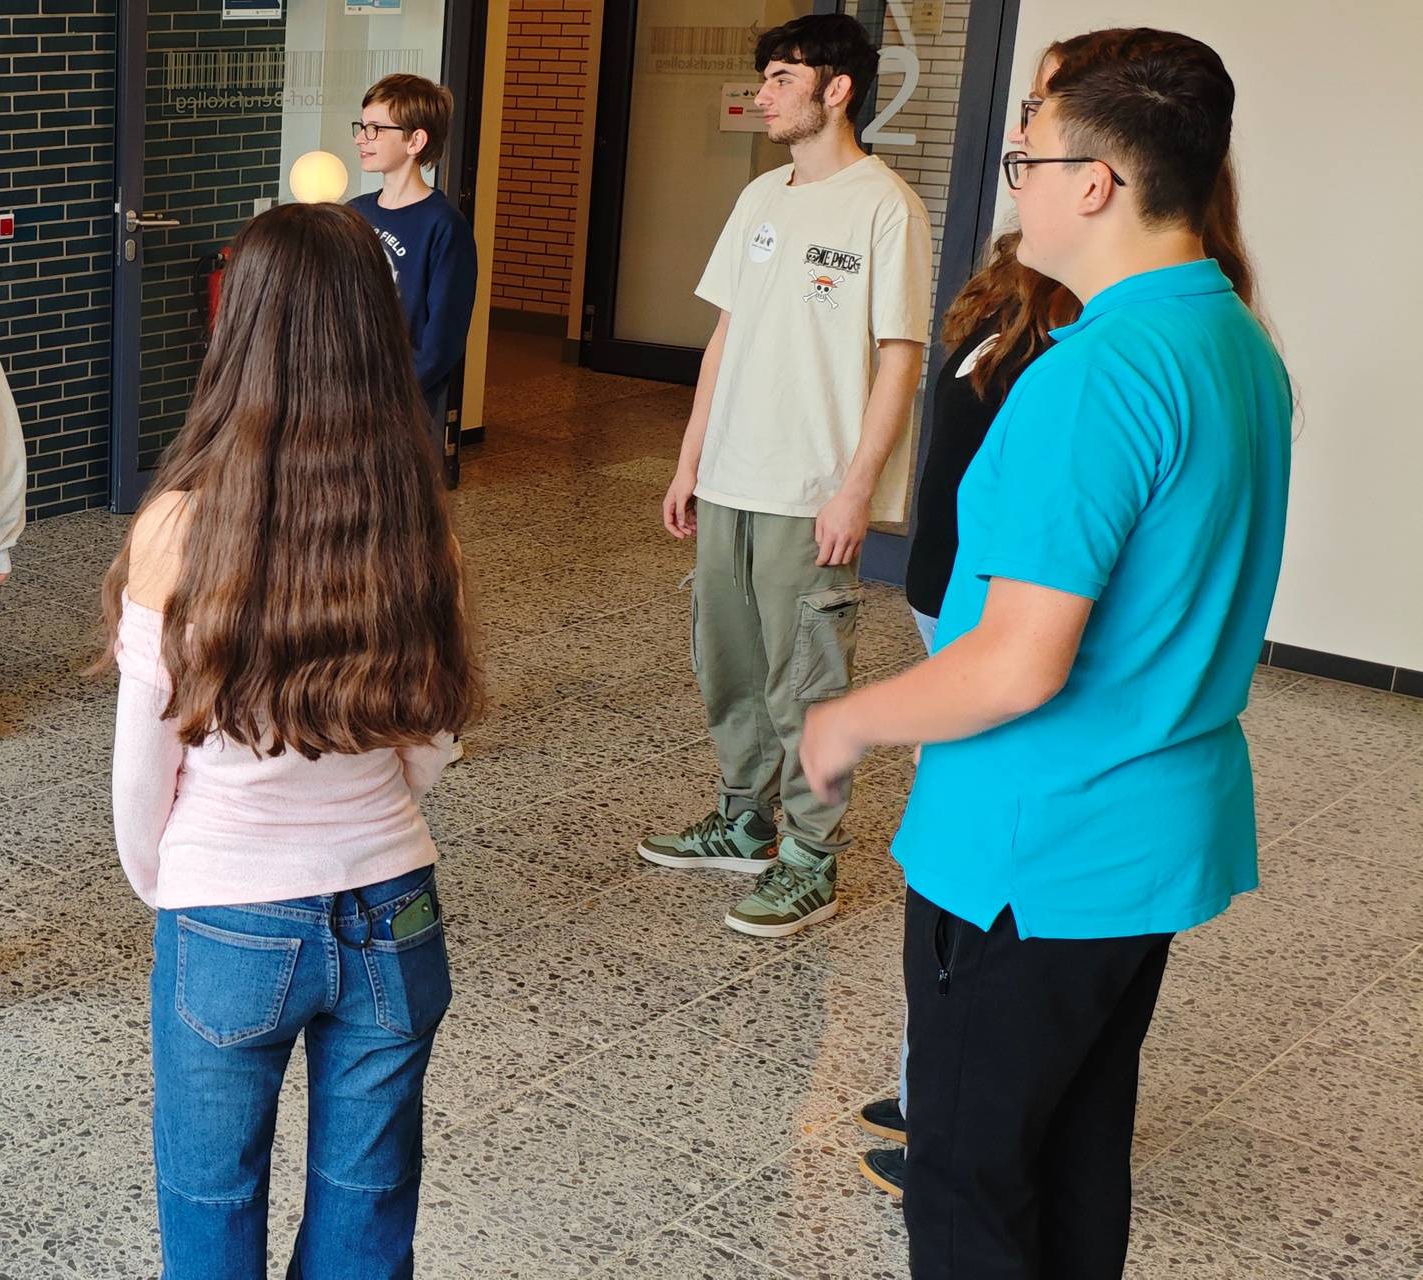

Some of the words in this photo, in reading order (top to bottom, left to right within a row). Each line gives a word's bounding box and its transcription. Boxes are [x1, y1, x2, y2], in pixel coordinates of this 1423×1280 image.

[379, 231, 407, 257] FIELD
[806, 247, 833, 266] ONE
[830, 252, 862, 272] PIECE
